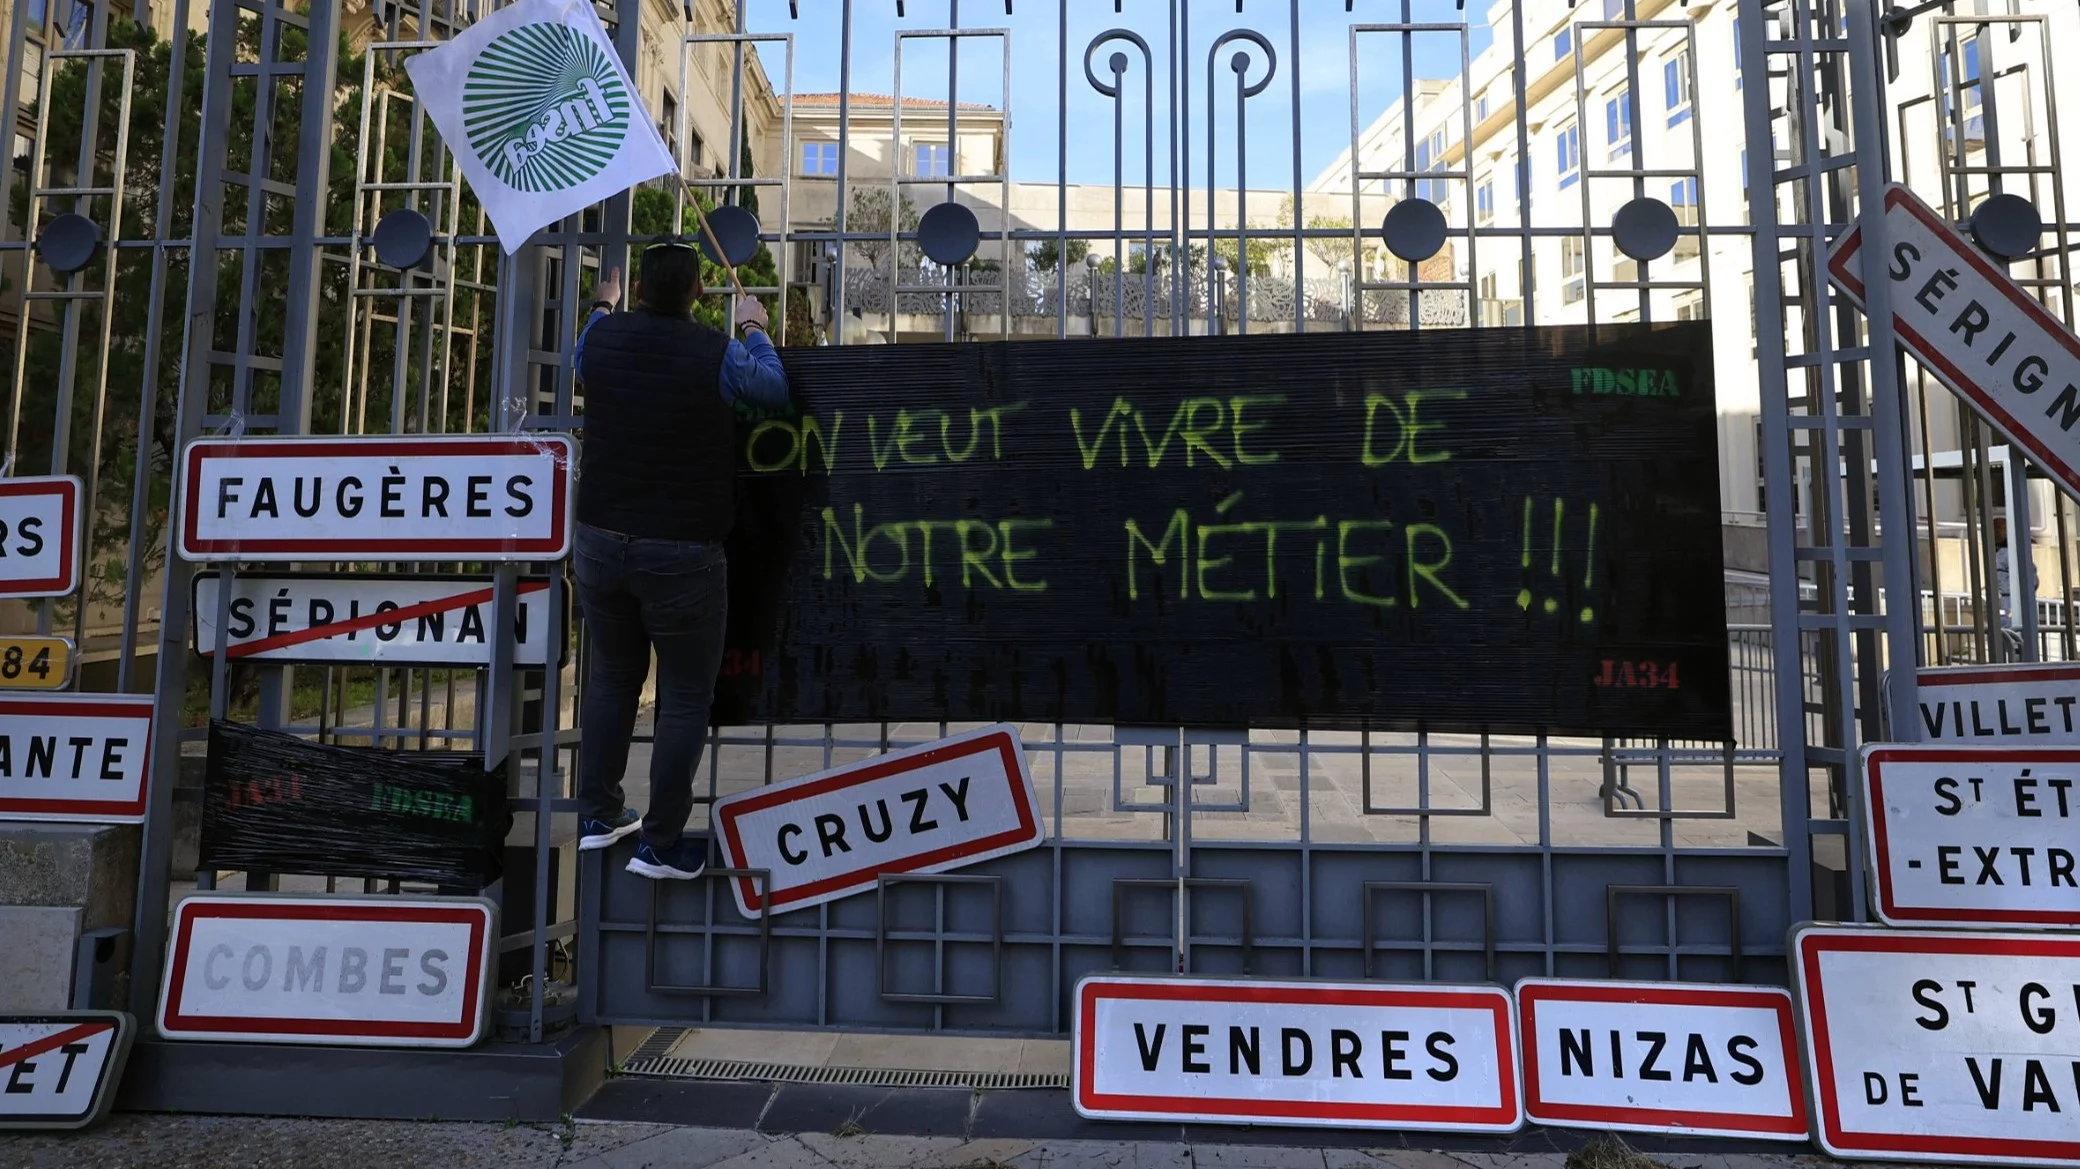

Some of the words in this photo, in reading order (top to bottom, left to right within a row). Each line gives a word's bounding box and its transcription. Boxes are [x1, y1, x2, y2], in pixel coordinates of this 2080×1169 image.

[1571, 368, 1680, 397] FDSEA
[746, 410, 843, 475] ON
[868, 402, 1028, 471] VEUT
[1361, 389, 1467, 466] DE
[218, 466, 534, 518] FAUGÈRES
[823, 503, 1053, 590] NOTRE
[1517, 497, 1599, 622] !!!
[1594, 660, 1680, 690] JA34
[1919, 696, 2076, 738] VILLET
[2014, 769, 2073, 818] ÉT
[777, 777, 970, 866] CRUZY
[203, 943, 449, 997] COMBES
[2019, 982, 2080, 1034] G
[0, 1043, 89, 1094] ET
[1133, 1023, 1460, 1082] VENDRES
[1559, 1028, 1764, 1085] NIZAS
[1863, 1072, 1924, 1107] DE
[1965, 1057, 2080, 1112] VA
